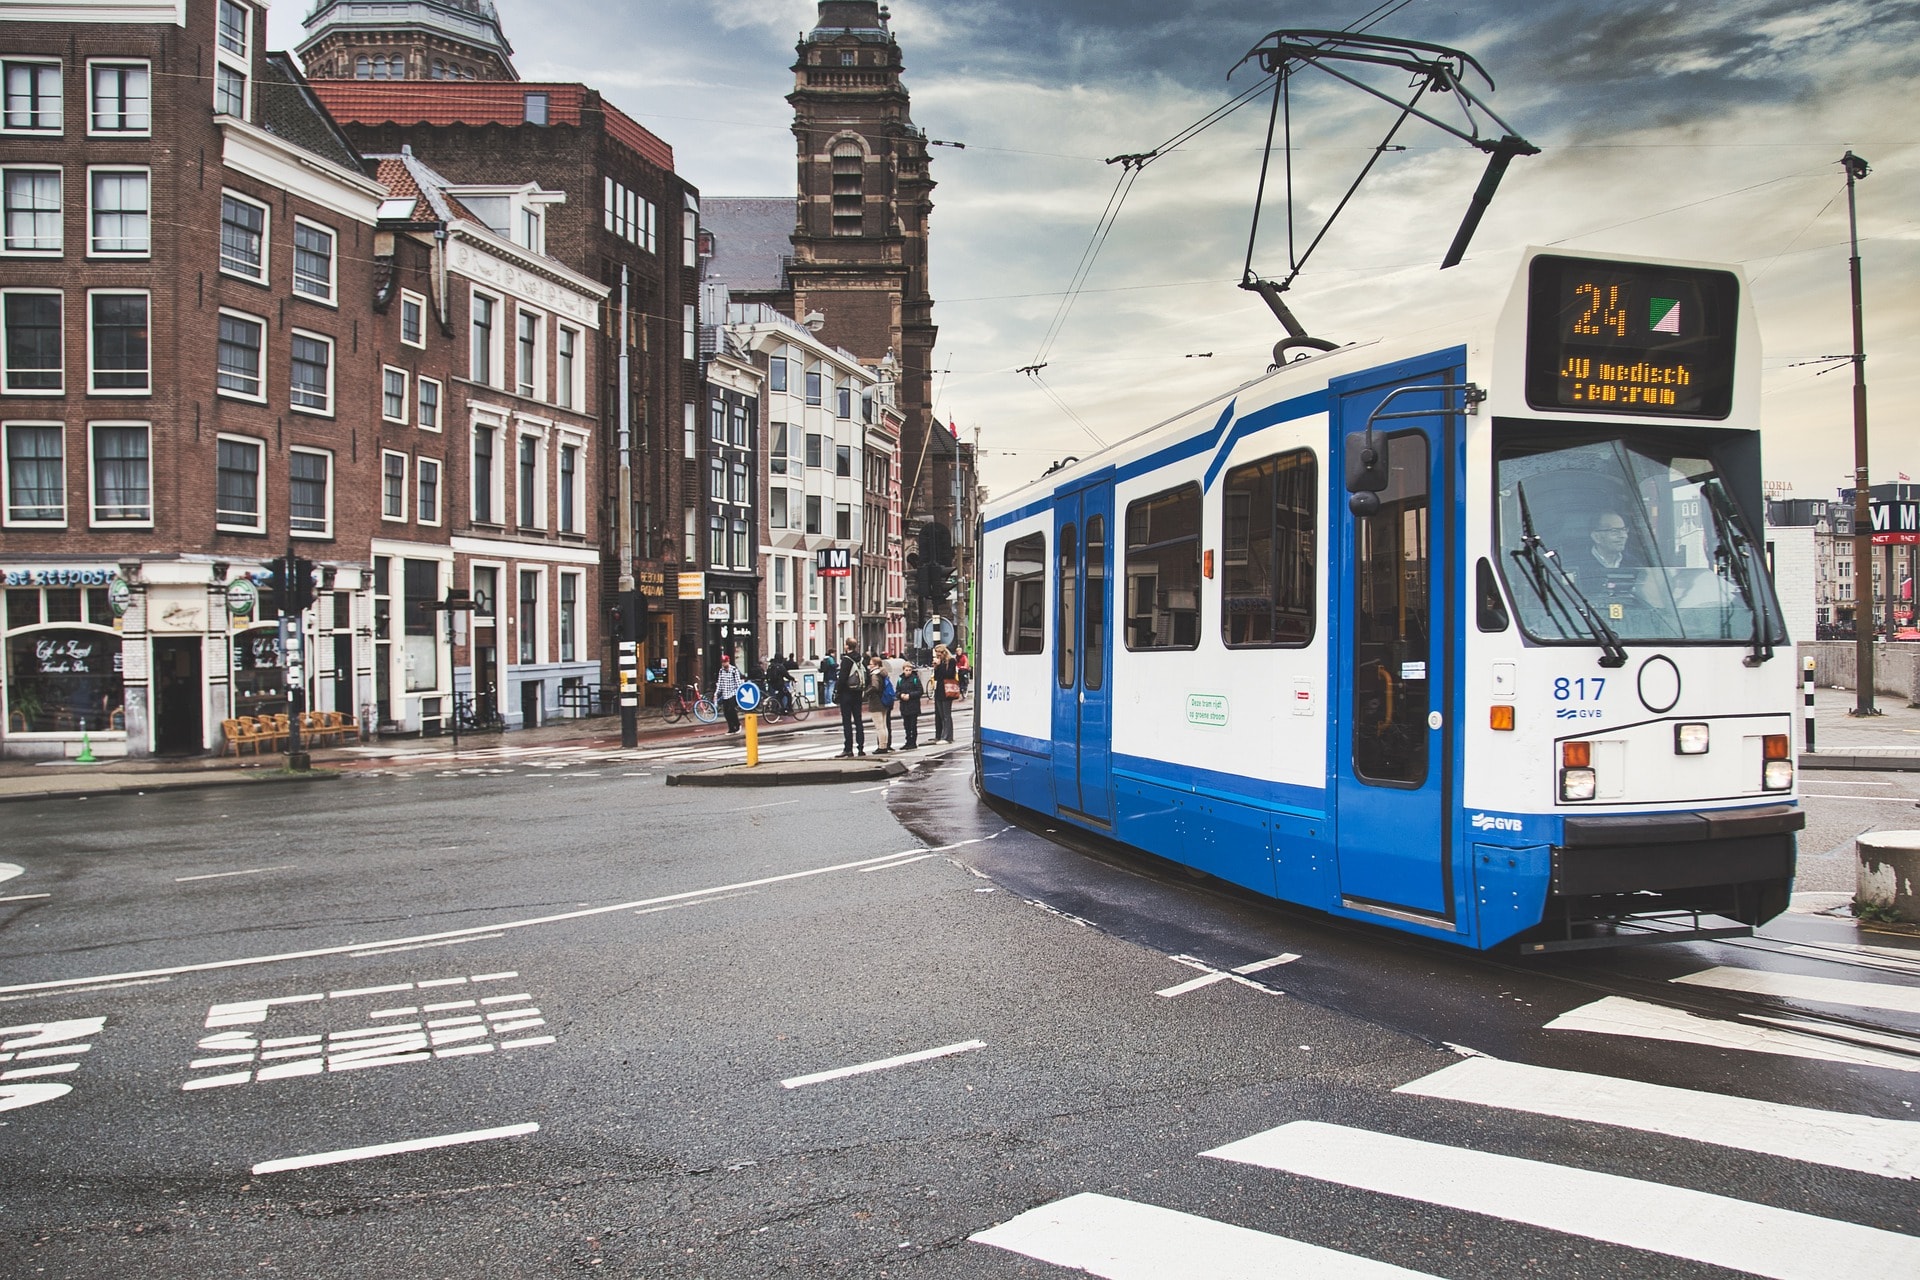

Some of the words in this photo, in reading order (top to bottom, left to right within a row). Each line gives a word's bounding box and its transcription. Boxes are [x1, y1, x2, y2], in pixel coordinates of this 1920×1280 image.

[1574, 283, 1626, 337] 24
[1600, 362, 1690, 386] medisch
[1763, 480, 1793, 491] TORIA
[1900, 504, 1916, 531] M
[831, 550, 847, 568] M
[989, 562, 999, 580] 817
[1612, 607, 1620, 617] 8
[998, 685, 1011, 702] GVB
[1553, 676, 1606, 702] 817
[1191, 698, 1201, 707] Deze
[1202, 700, 1212, 708] tram
[1195, 711, 1209, 721] groene
[1210, 712, 1226, 722] stroom
[1579, 708, 1603, 719] GVB
[1495, 816, 1523, 833] GVB
